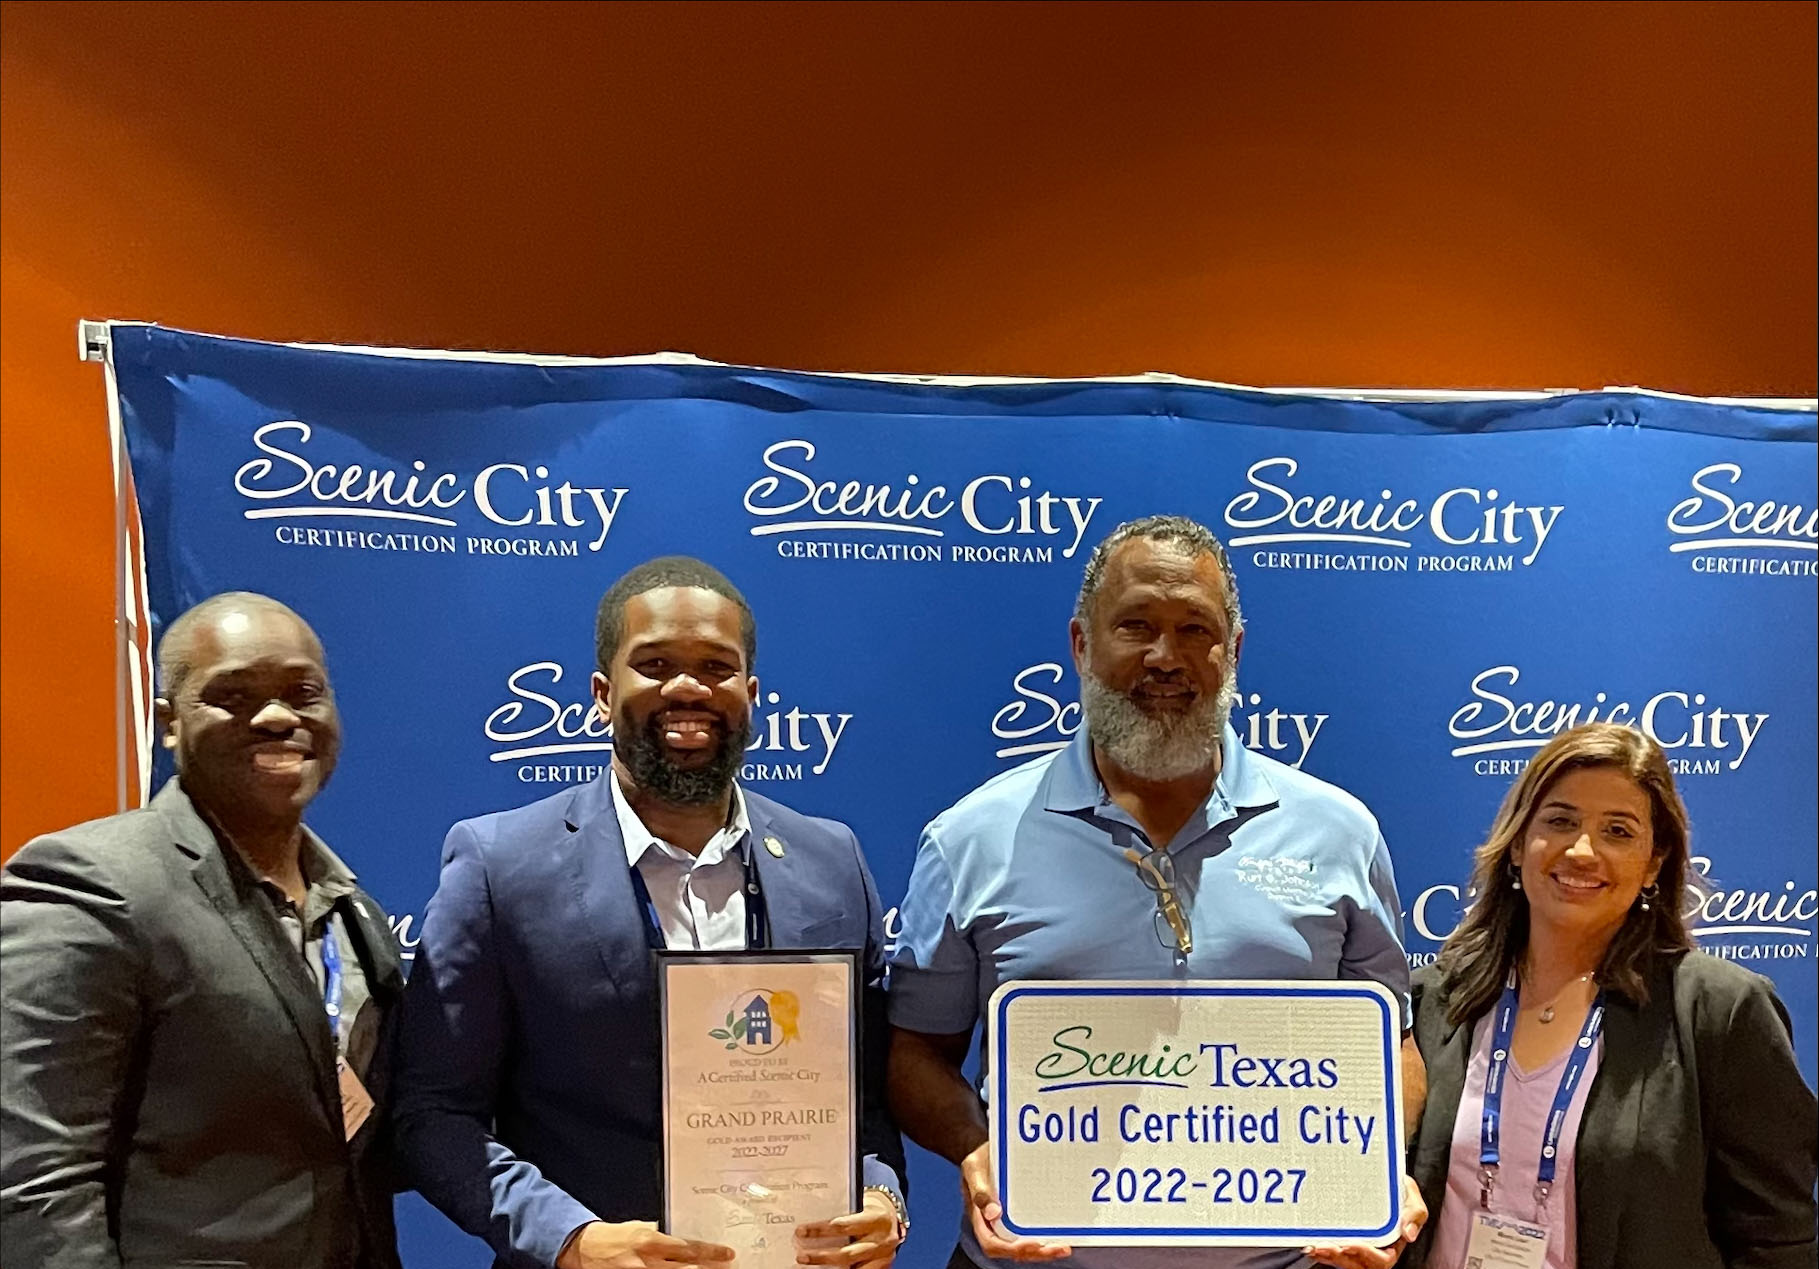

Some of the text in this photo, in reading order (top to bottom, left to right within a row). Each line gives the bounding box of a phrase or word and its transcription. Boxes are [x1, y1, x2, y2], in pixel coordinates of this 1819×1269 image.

[234, 420, 630, 552] Scenic City
[743, 440, 1103, 558] Scenic City
[1224, 457, 1565, 566] Scenic City
[1667, 463, 1818, 538] Scen
[275, 526, 578, 557] CERTIFICATION PROGRAM
[777, 540, 1052, 563] CERTIFICATION PROGRAM
[1253, 551, 1513, 572] CERTIFICATION PROGRAM
[1692, 556, 1818, 576] CERTIFICATI
[484, 662, 614, 742] Sce
[1641, 691, 1770, 770] City
[1229, 692, 1329, 770] ity
[737, 763, 803, 781] GRAM
[1035, 1026, 1338, 1089] Scenic Texas
[686, 1108, 838, 1129] GRAND PRAIRIE
[1019, 1104, 1376, 1155] Gold Certified City
[1090, 1168, 1307, 1203] 2022-2027
